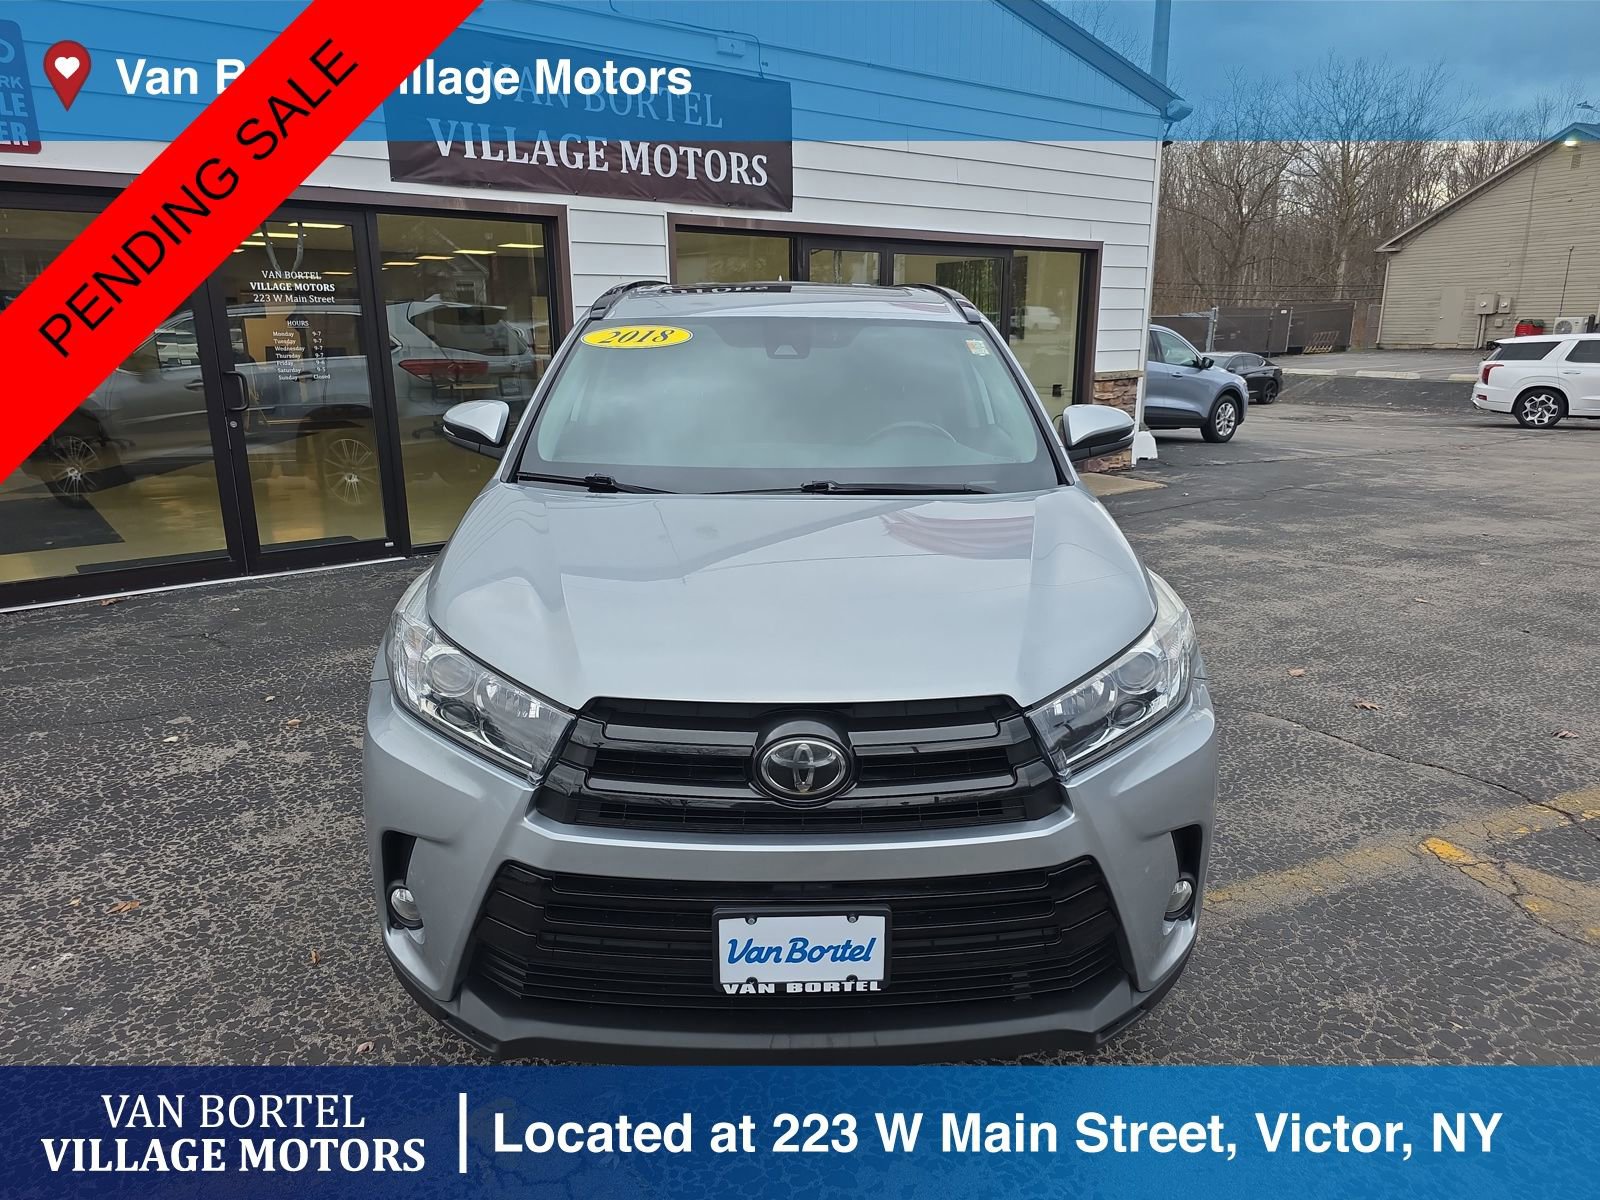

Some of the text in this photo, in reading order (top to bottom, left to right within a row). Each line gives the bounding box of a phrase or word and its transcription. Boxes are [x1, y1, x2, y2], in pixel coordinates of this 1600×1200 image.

[426, 118, 768, 187] VILLAGE MOTORS
[262, 270, 281, 279] VAN
[250, 282, 335, 292] VILLAGE MOTORS
[253, 293, 335, 303] 223 W Main Street
[597, 329, 675, 343] 2018
[727, 937, 877, 964] Van Bortel
[722, 980, 882, 995] VAN BORTEL
